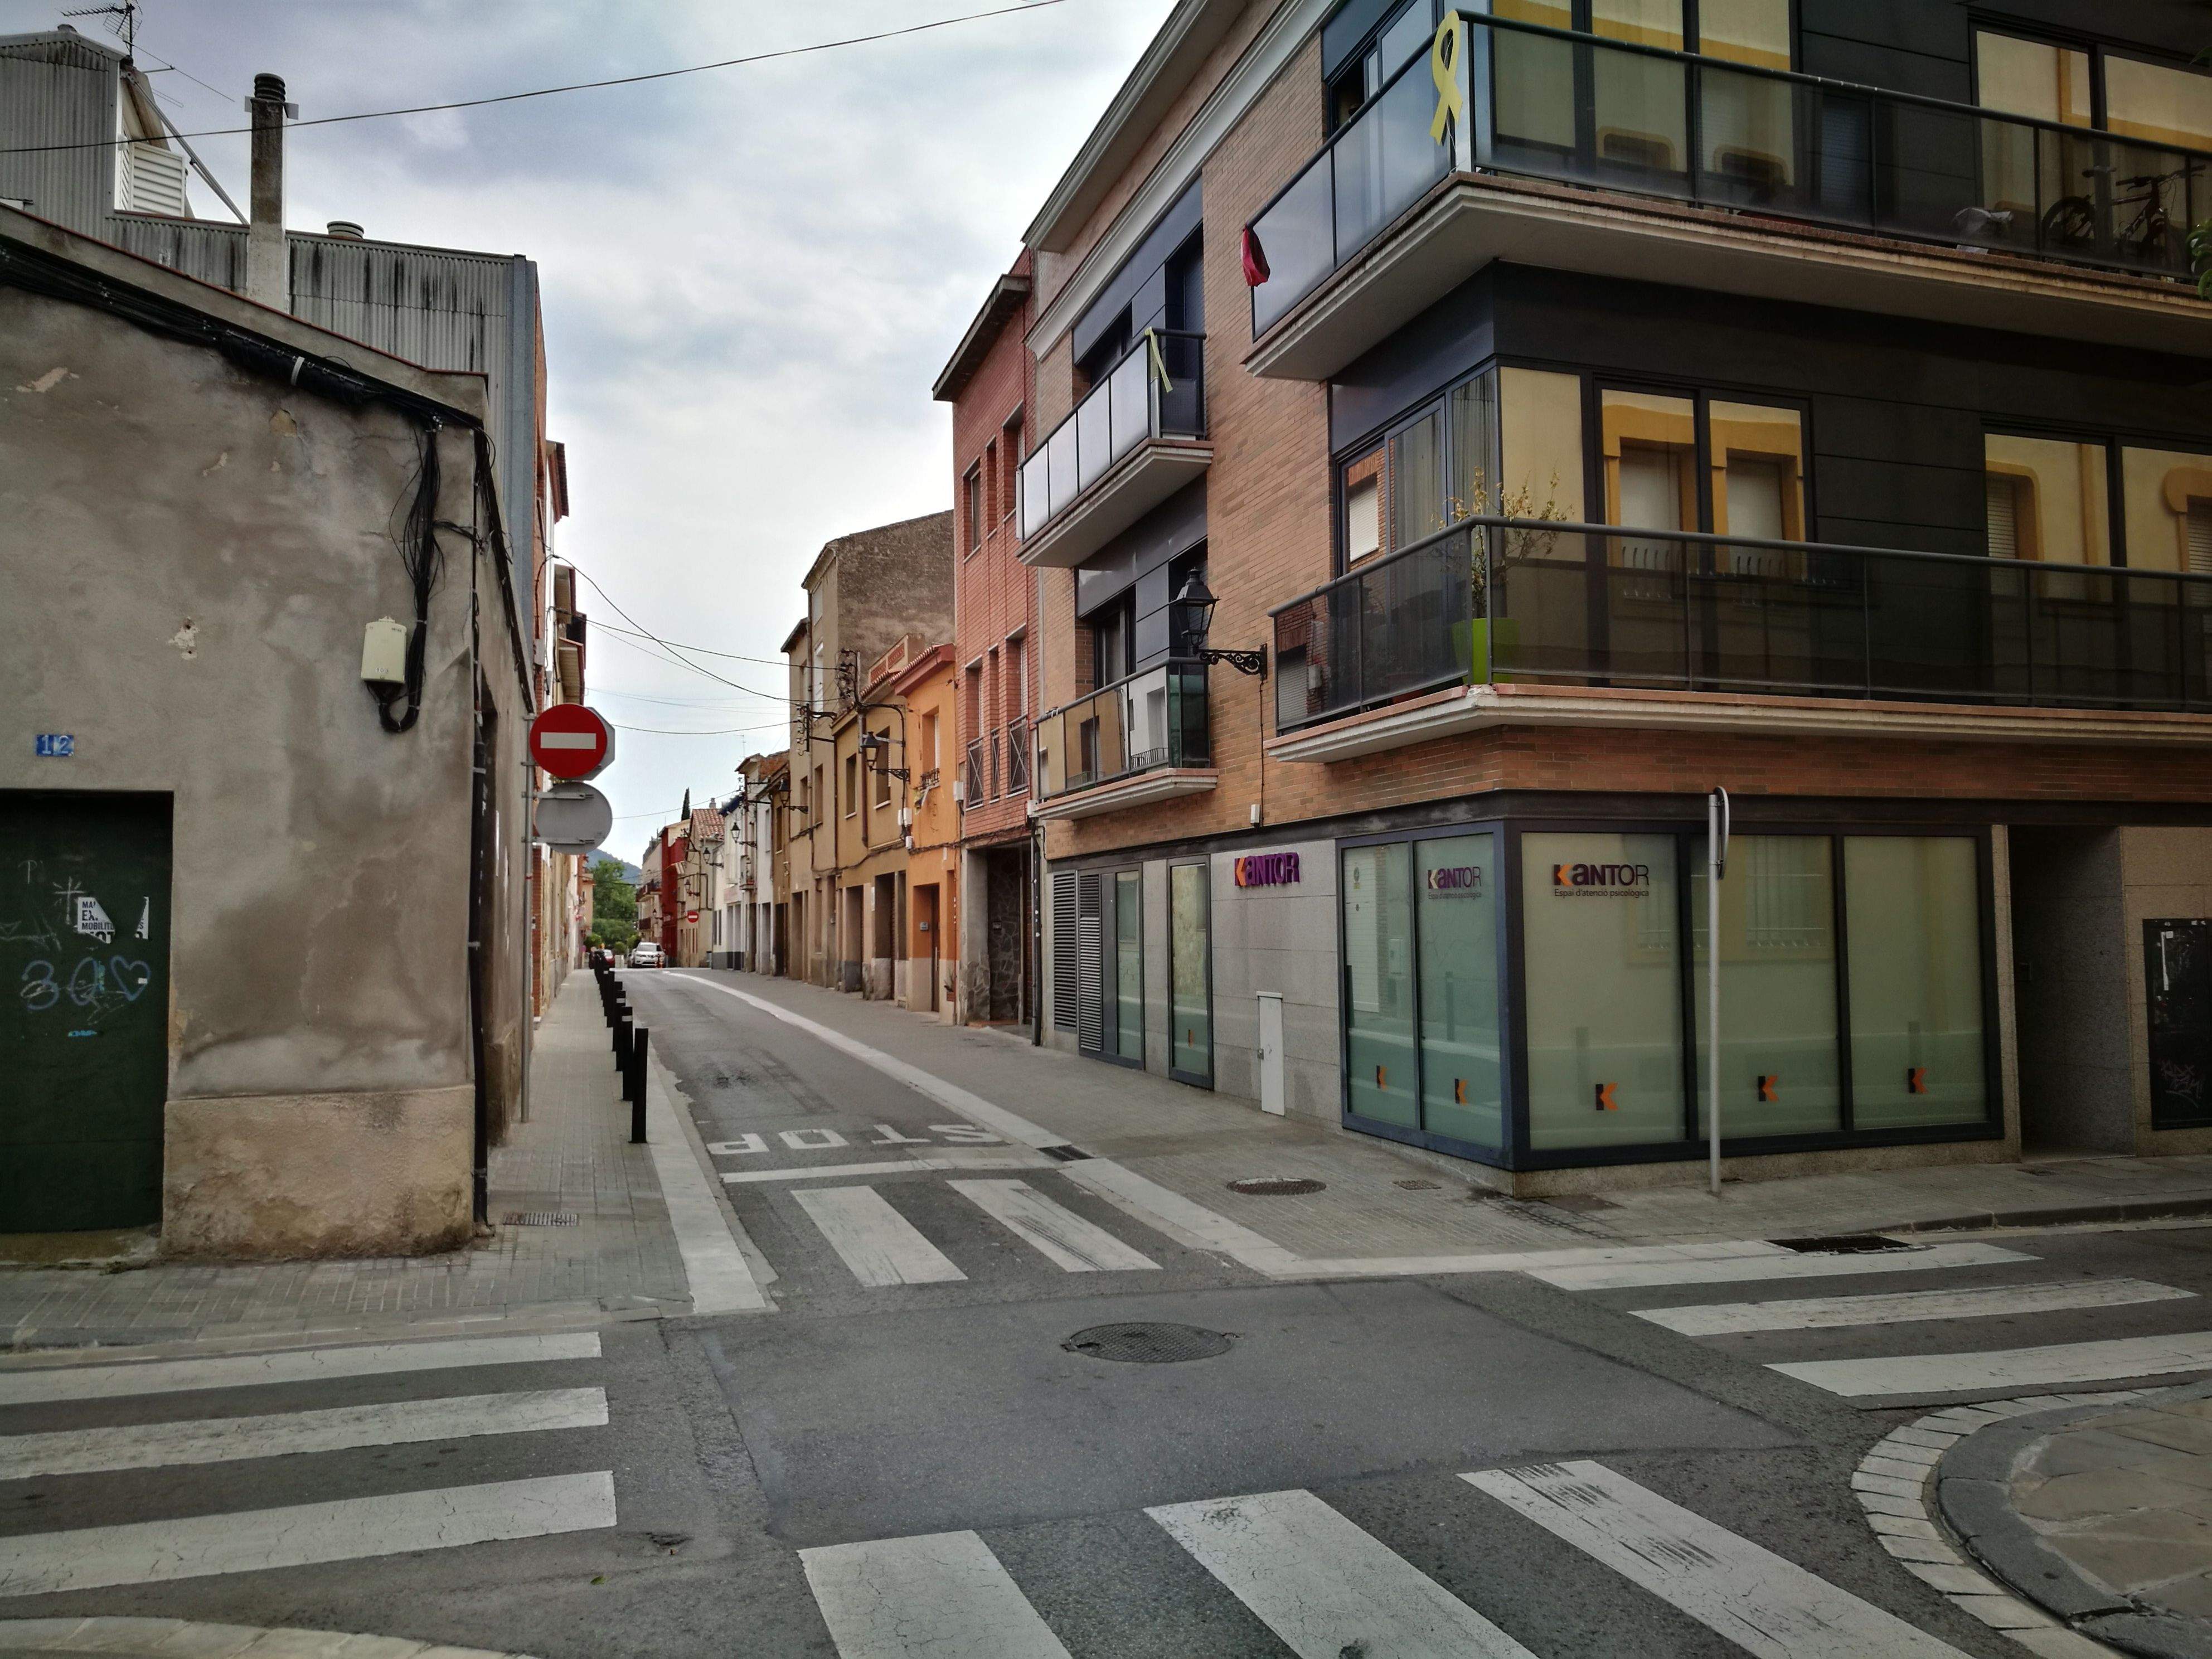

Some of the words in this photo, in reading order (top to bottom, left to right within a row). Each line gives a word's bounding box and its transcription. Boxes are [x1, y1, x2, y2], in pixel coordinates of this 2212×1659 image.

[42, 735, 69, 754] 12
[1554, 889, 1574, 898] Espai
[1576, 888, 1608, 896] d'atenció
[706, 1124, 1005, 1155] STOP
